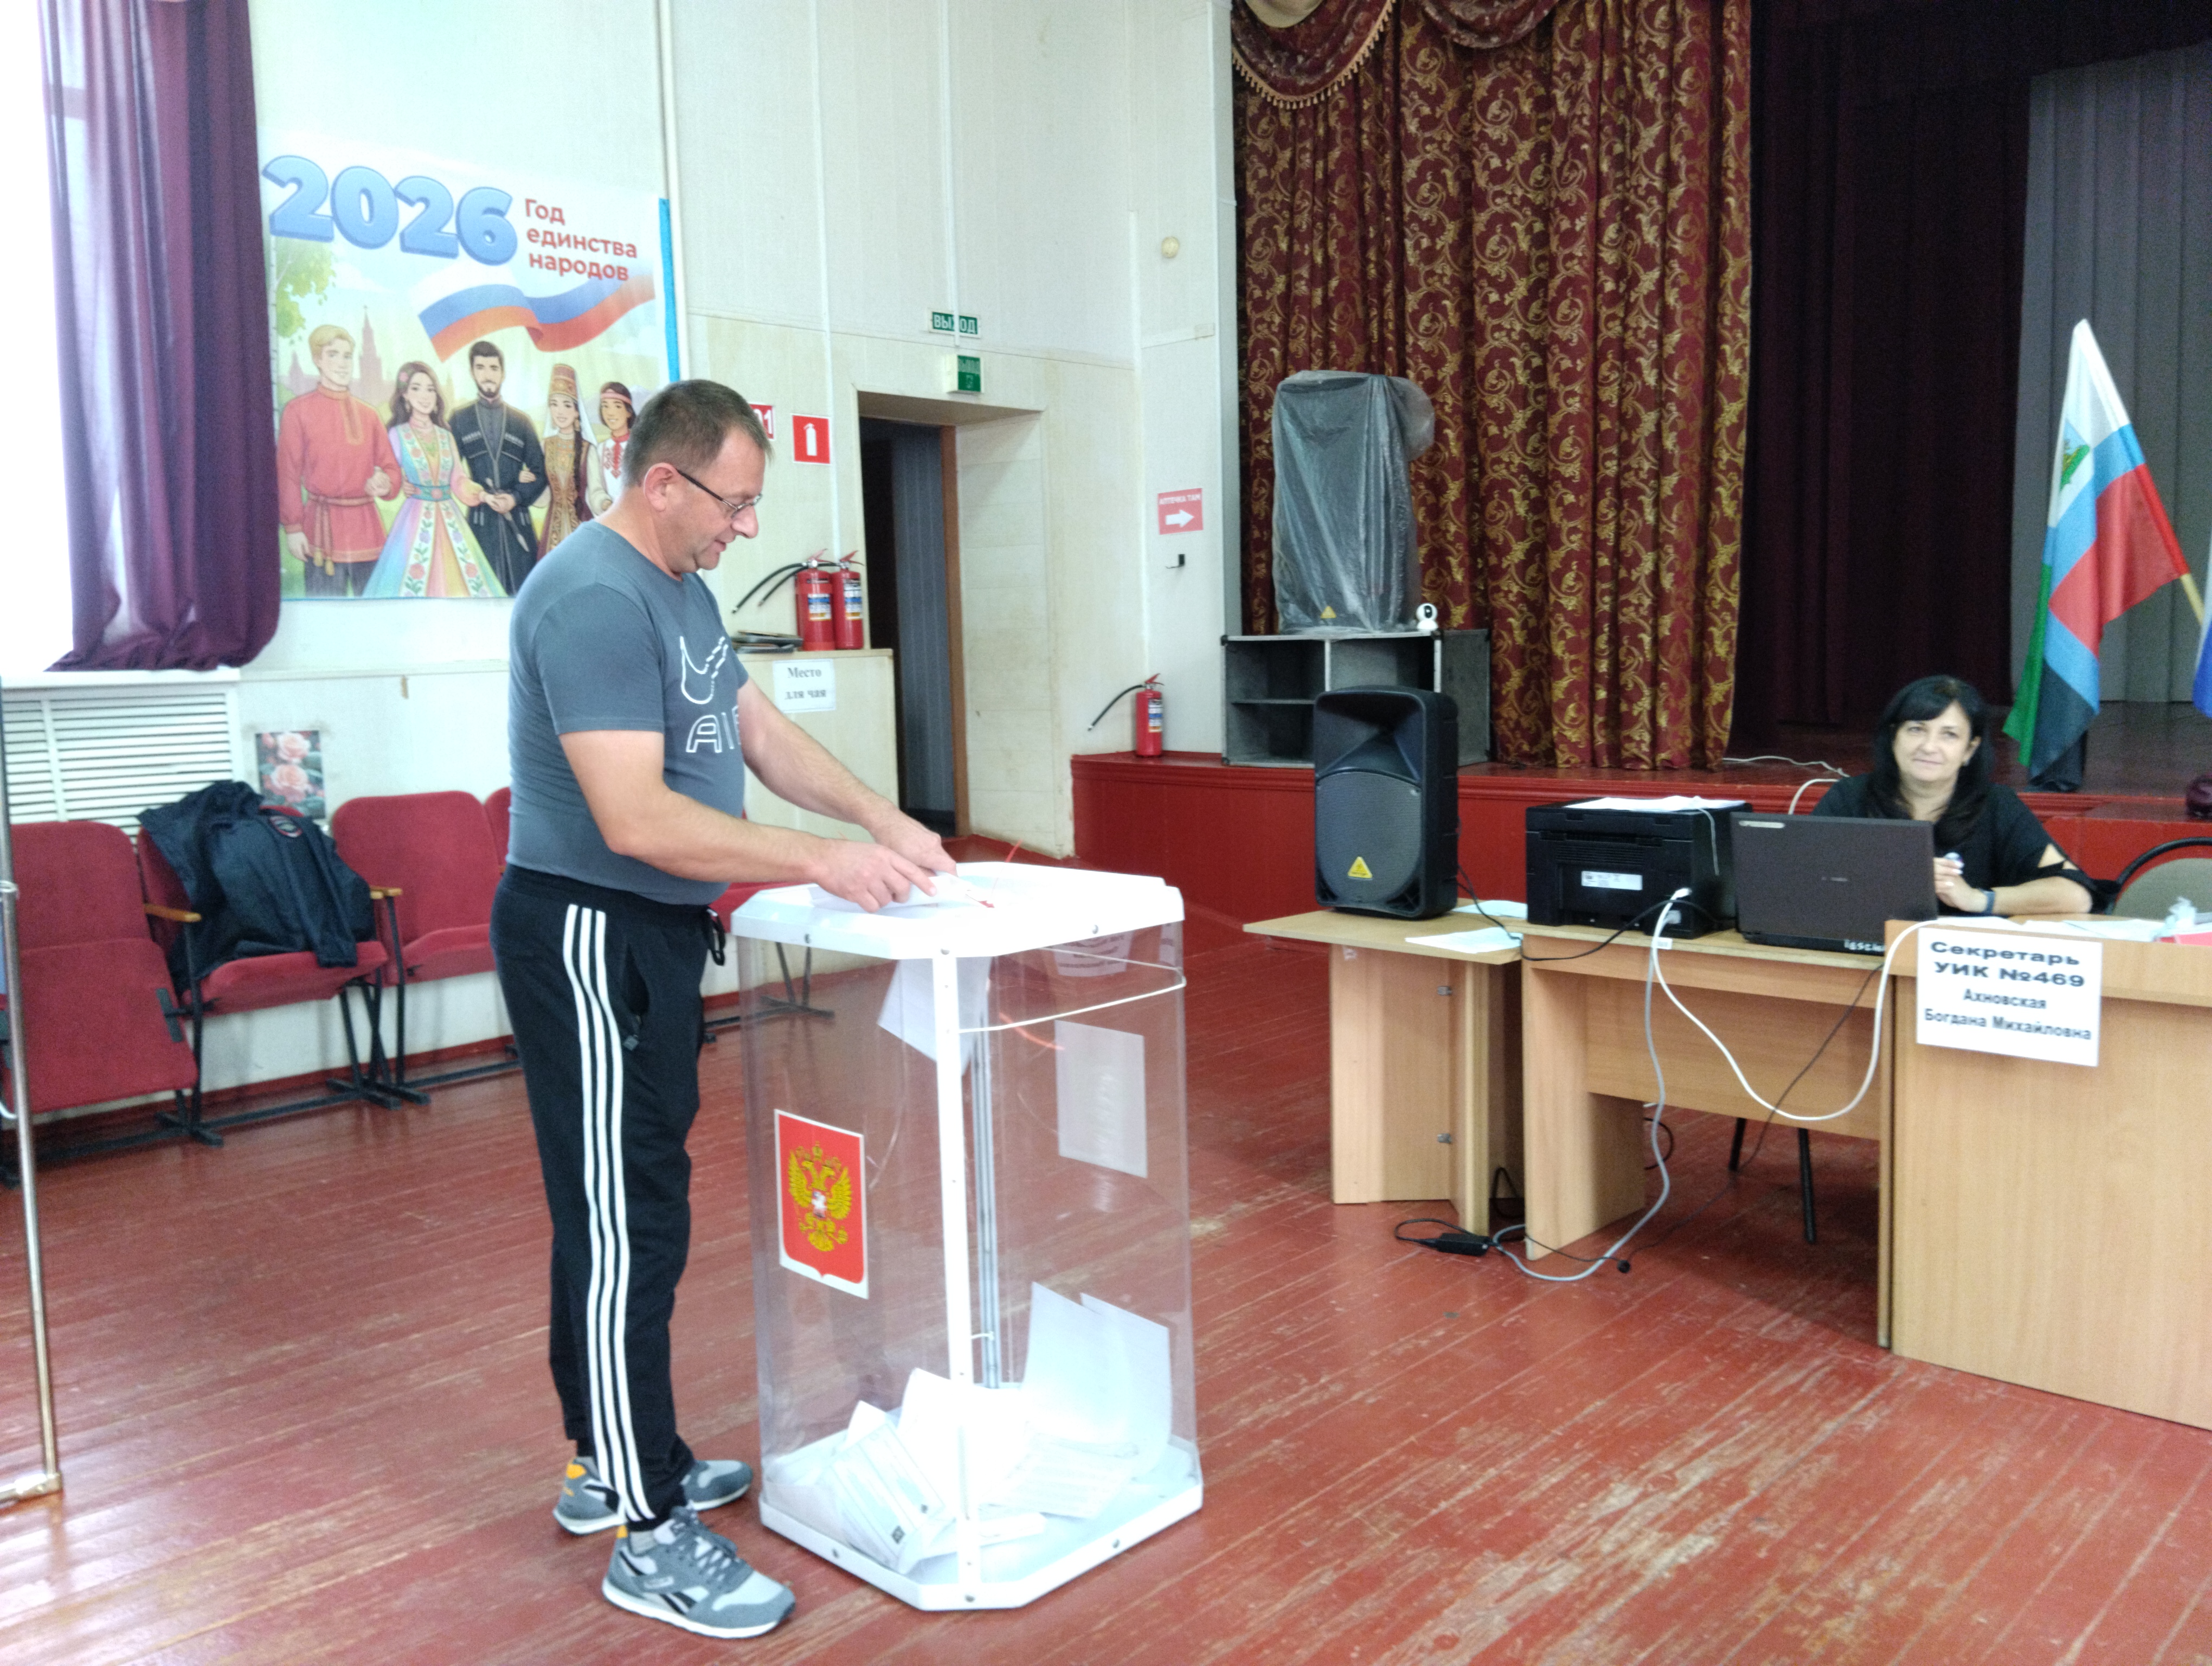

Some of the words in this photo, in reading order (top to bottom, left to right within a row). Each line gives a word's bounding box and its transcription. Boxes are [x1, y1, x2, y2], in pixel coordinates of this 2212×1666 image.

[261, 155, 518, 266] 2026
[525, 197, 565, 226] Год
[526, 228, 638, 259] единства
[529, 252, 629, 281] народов
[933, 315, 976, 334] ВЫОД
[788, 667, 821, 677] Место
[1931, 941, 2080, 966] Секретарь
[1934, 961, 1989, 978] УИК
[1999, 968, 2085, 987] №469
[1963, 988, 2047, 1009] Ахновская
[1925, 1008, 1988, 1027] Богдана
[1992, 1015, 2092, 1040] Михайловна
